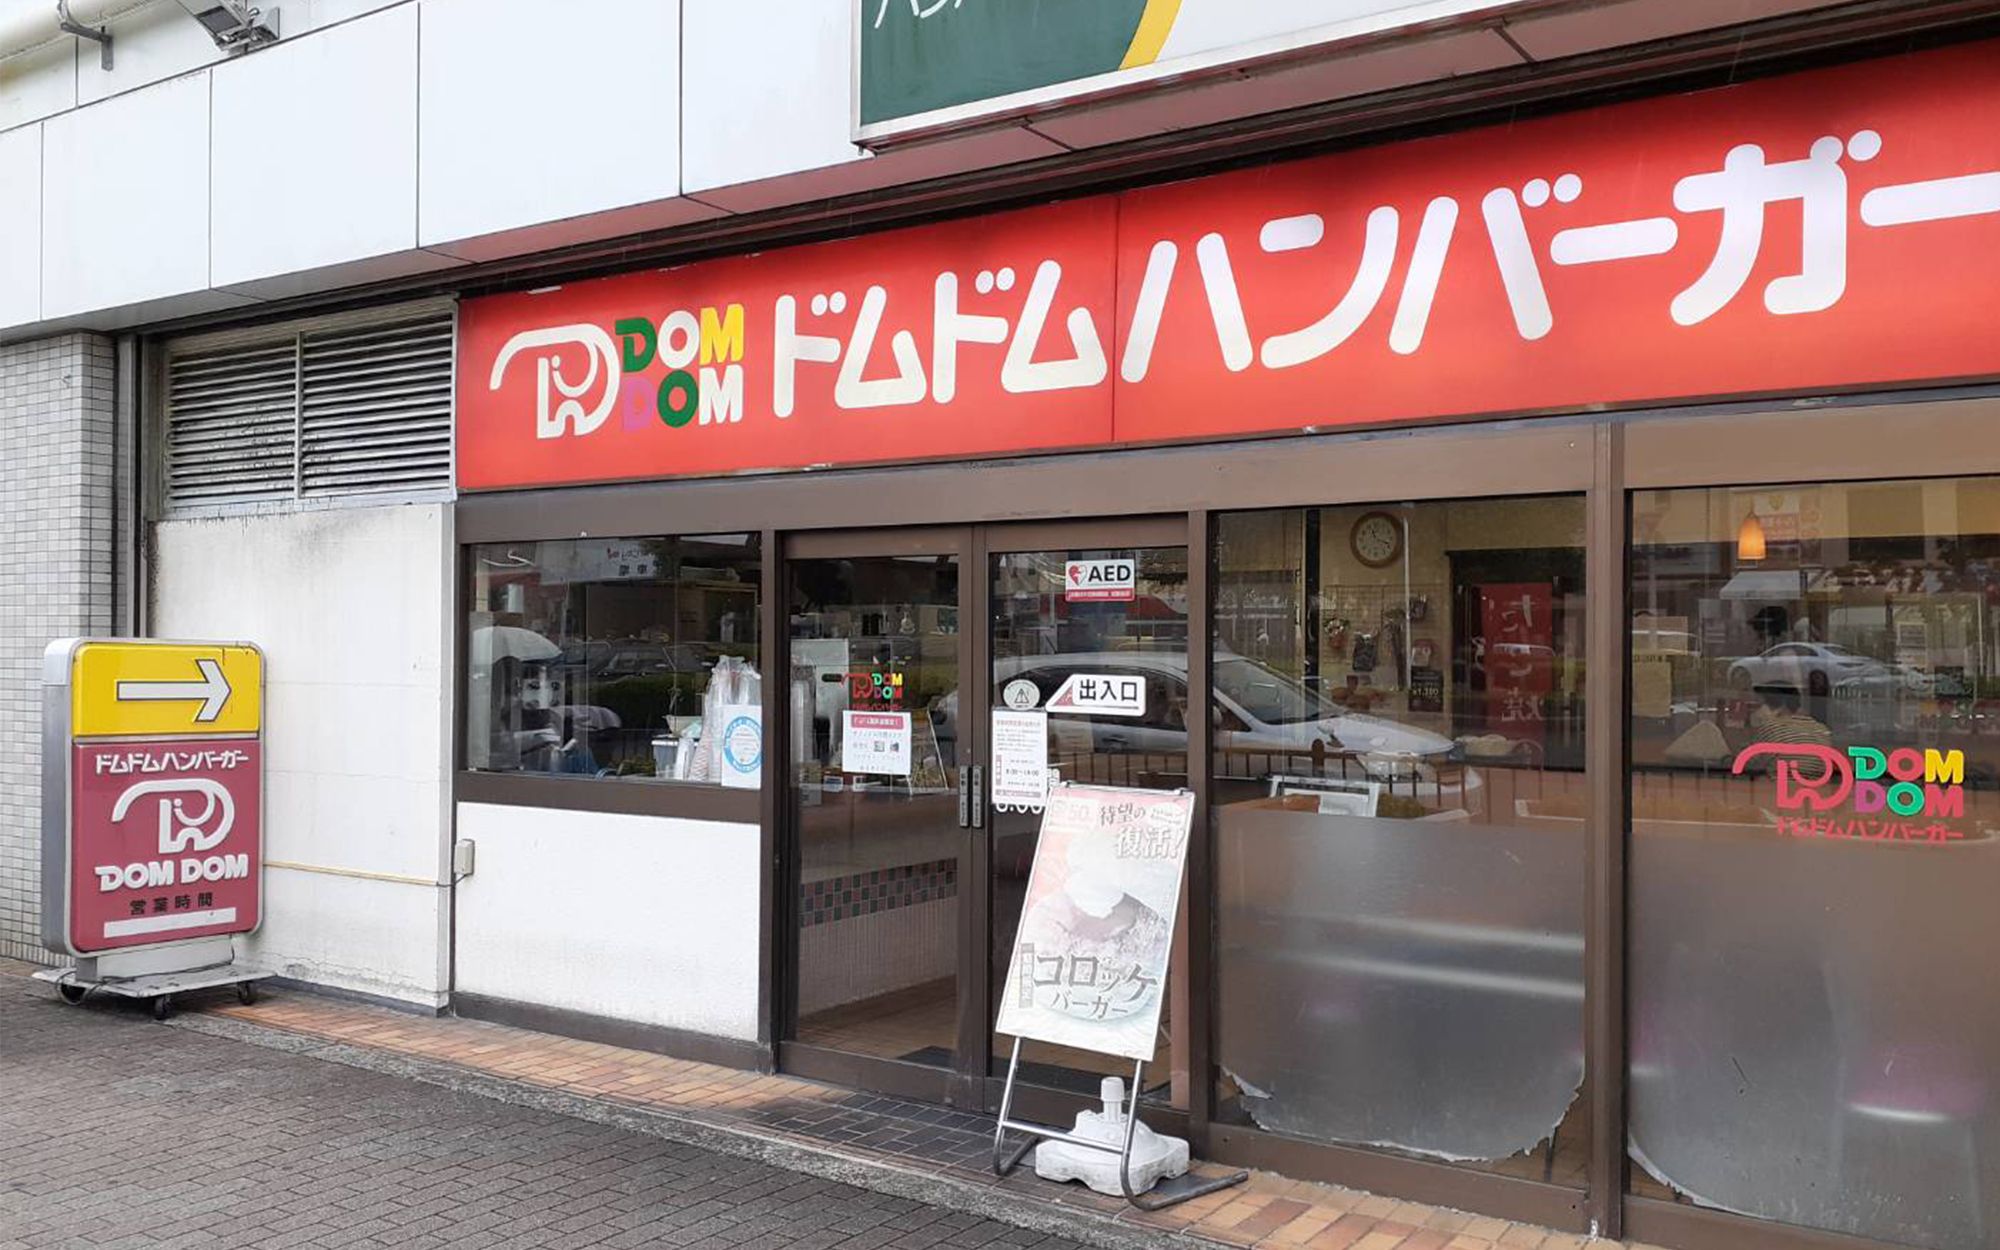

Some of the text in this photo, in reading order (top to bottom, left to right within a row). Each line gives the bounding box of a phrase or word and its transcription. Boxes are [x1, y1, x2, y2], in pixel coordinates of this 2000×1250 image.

[773, 129, 2000, 418] ドムドムハンバーガー
[615, 303, 744, 373] DOM
[622, 364, 744, 432] DOM
[1088, 565, 1131, 582] AED
[871, 673, 903, 686] DOM
[1079, 679, 1137, 701] 出入口
[96, 750, 249, 774] ドムドムハンバーガー
[1848, 746, 1964, 784] DOM
[1100, 803, 1146, 826] 待望の
[1855, 781, 1964, 818] DOM
[95, 853, 249, 891] DOM DOM
[130, 892, 213, 915] 営業時間
[1034, 954, 1158, 1002] コロッケ
[1052, 990, 1129, 1019] バーガー
